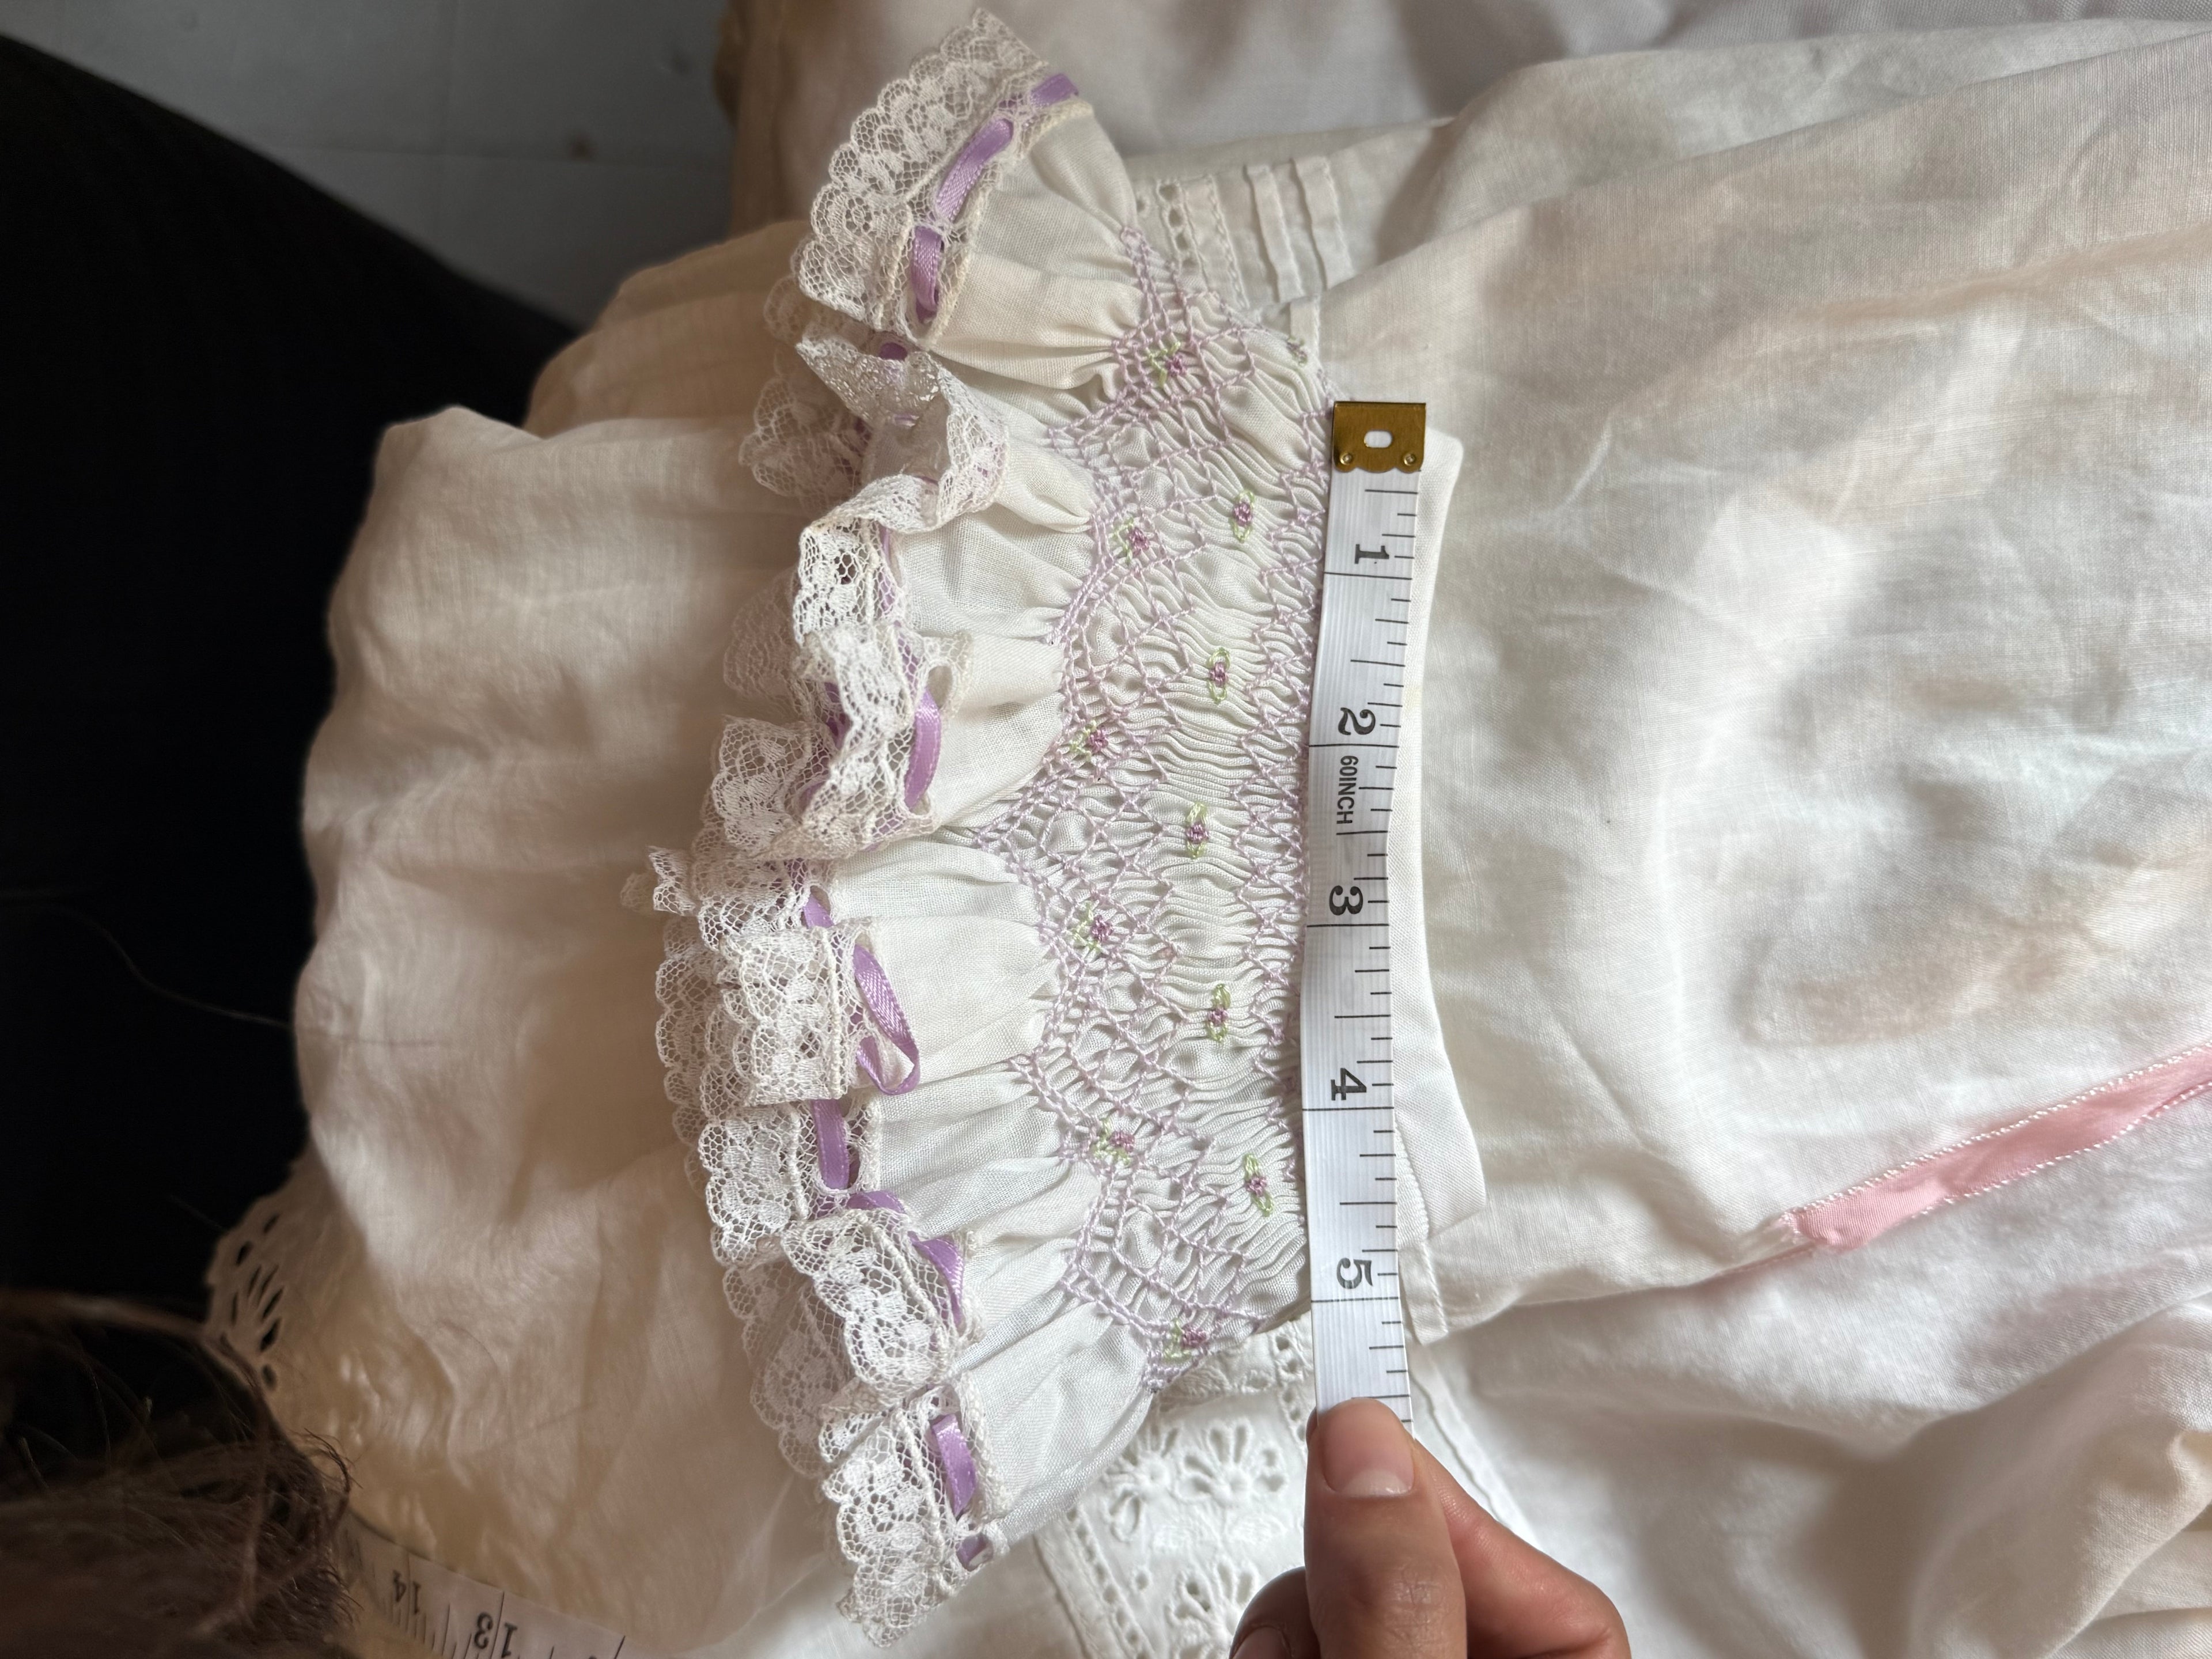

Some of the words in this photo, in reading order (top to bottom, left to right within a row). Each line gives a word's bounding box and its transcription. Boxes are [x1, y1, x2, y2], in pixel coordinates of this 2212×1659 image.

[1354, 544, 1389, 564] 1
[1337, 707, 1376, 736] 2
[1336, 755, 1359, 825] 60INCH
[1329, 885, 1363, 916] 3
[1330, 1067, 1368, 1101] 4
[1336, 1257, 1374, 1290] 5
[392, 1570, 421, 1614] 14
[474, 1612, 518, 1658] 13
